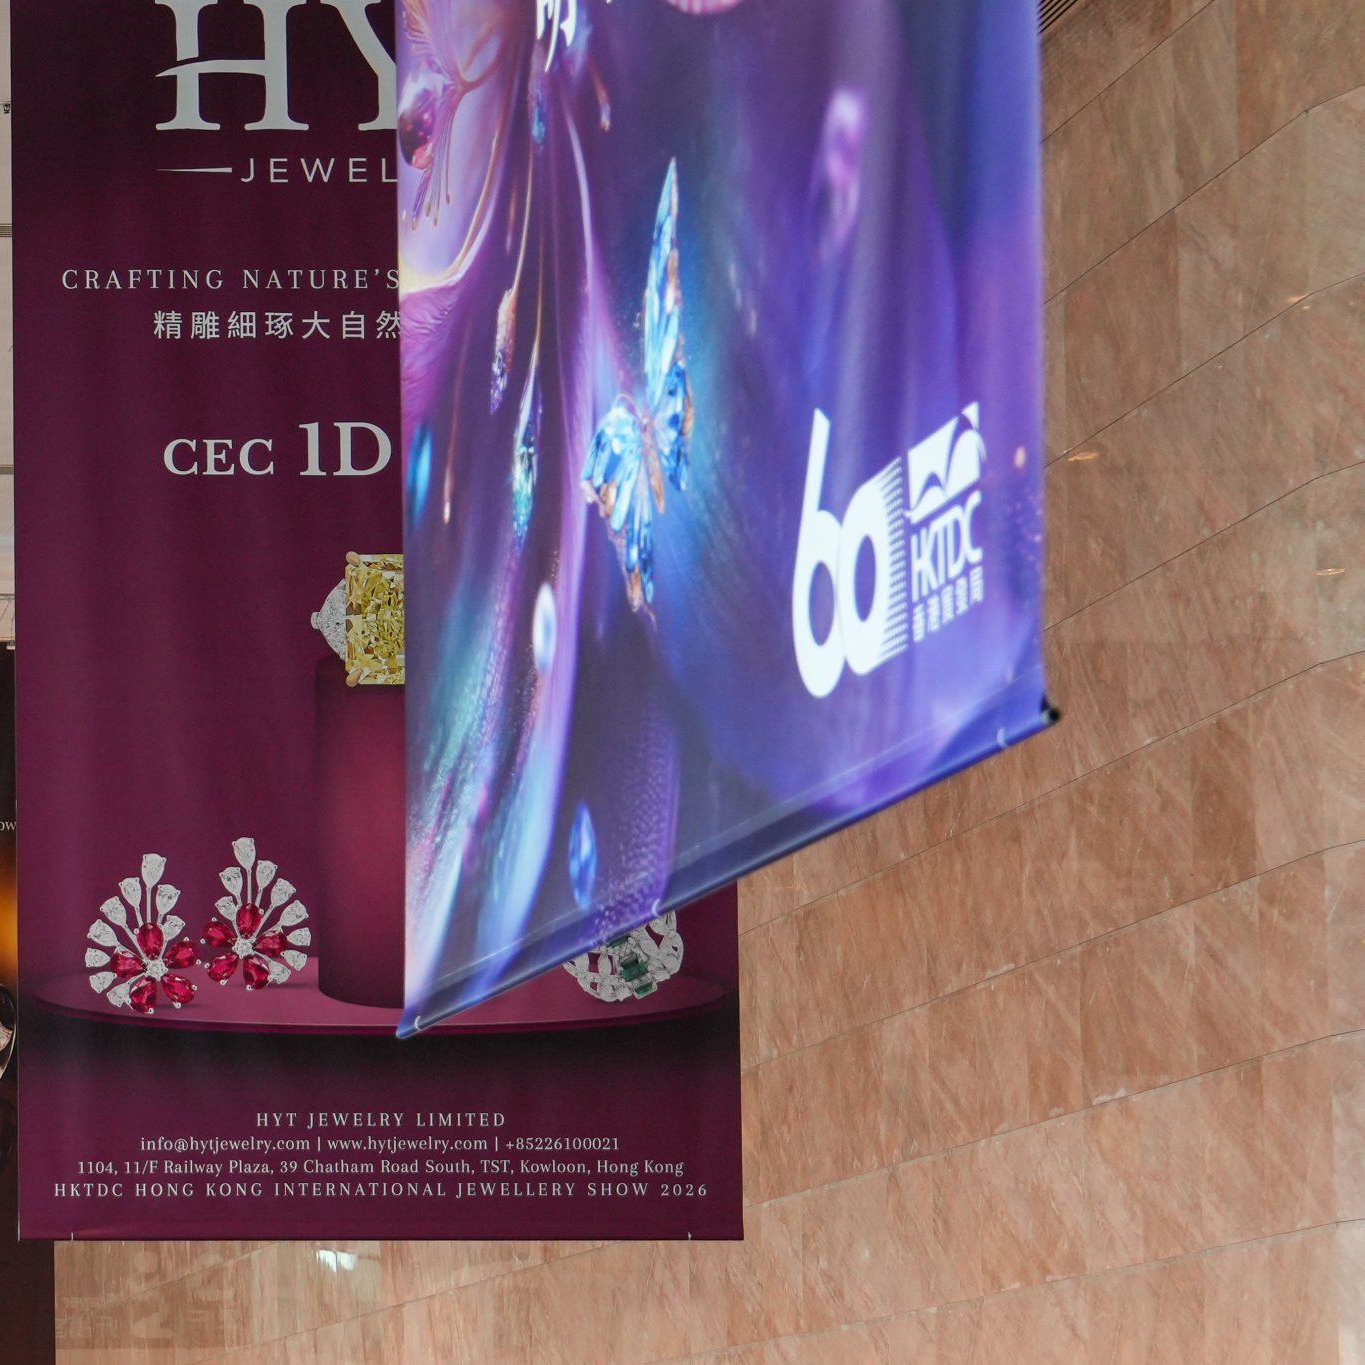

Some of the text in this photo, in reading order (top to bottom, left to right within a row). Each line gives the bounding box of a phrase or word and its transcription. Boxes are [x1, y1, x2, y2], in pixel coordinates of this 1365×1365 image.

[62, 268, 224, 290] CRAFTING
[153, 310, 401, 341] 精雕細琢大自然
[163, 438, 274, 476] CEC
[910, 489, 983, 603] HKTDC
[141, 1135, 310, 1155] info@hytjewelry.com
[327, 1135, 488, 1154] www.hytjewelry.com
[505, 1137, 618, 1151] +85226100021
